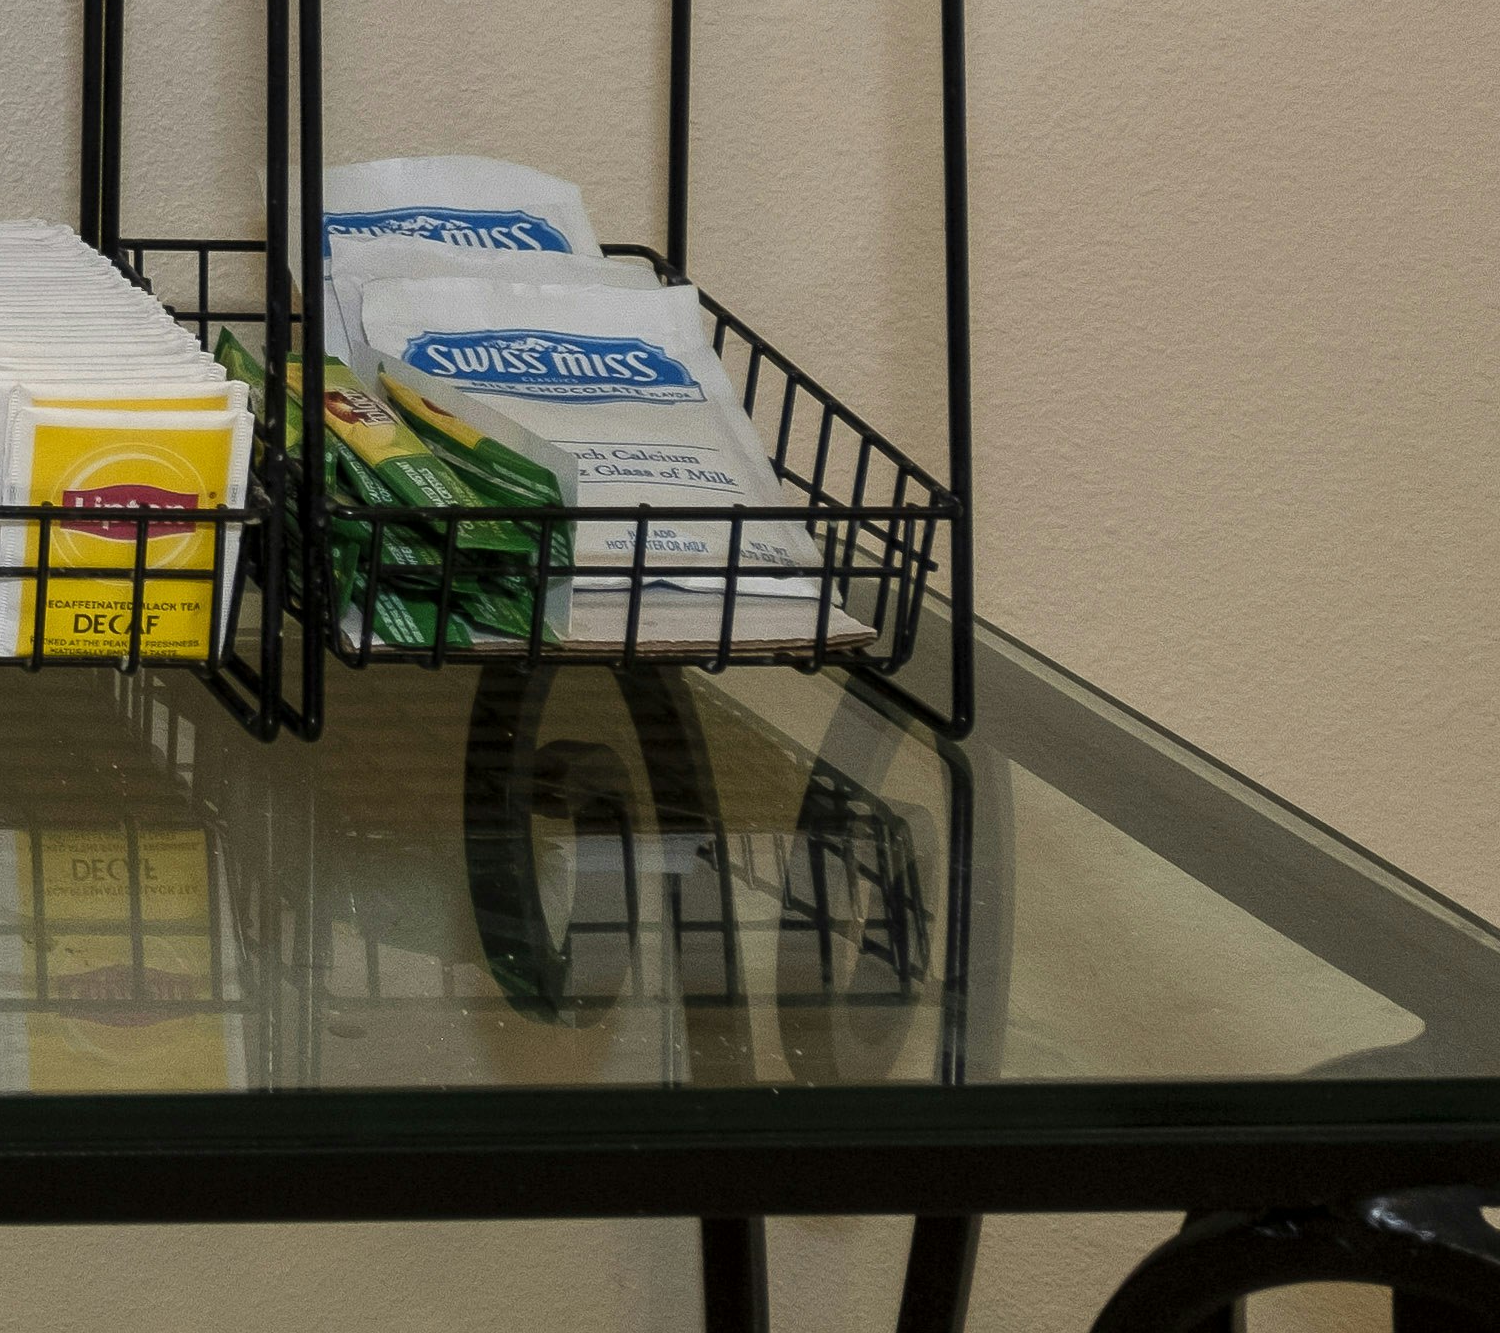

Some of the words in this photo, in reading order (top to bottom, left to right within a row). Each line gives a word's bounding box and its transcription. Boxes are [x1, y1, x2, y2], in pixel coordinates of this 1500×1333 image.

[426, 343, 548, 376] SWISS
[551, 350, 658, 382] MISS
[525, 384, 645, 396] CHOCOLATE
[612, 449, 701, 465] Calcium
[594, 465, 654, 477] Glass
[659, 467, 680, 480] of
[683, 469, 739, 486] Milk
[630, 540, 666, 551] TER
[45, 599, 133, 611] ECAFFEINATED
[141, 600, 177, 611] LACK
[180, 602, 201, 612] TEA
